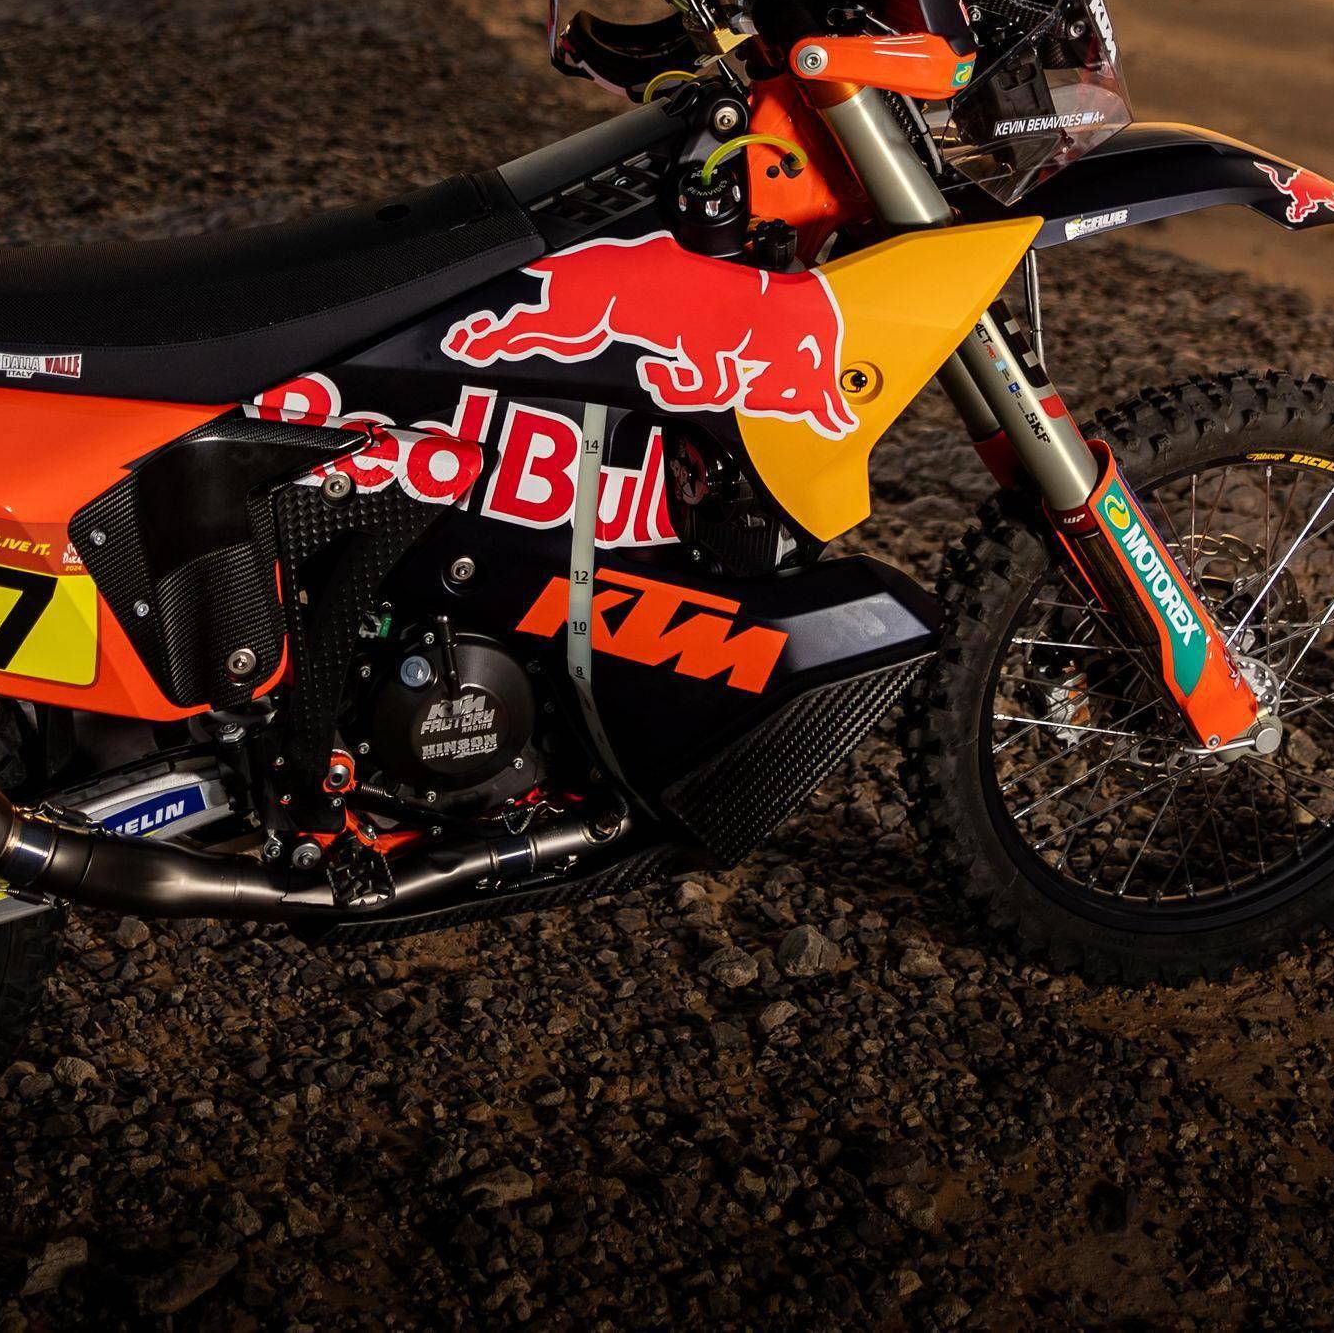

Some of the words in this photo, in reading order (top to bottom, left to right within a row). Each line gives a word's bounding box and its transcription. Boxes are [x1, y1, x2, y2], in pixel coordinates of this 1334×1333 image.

[995, 120, 1025, 136] KEVIN
[1027, 113, 1083, 131] BENAVIDES
[1092, 111, 1105, 124] A+
[975, 321, 993, 344] ACT
[2, 354, 40, 371] DALLA
[45, 355, 80, 376] VALLE
[1025, 412, 1050, 443] SKF
[584, 439, 600, 451] 14
[1064, 513, 1085, 524] WP
[32, 542, 51, 555] IT.
[574, 570, 589, 581] 12
[1121, 522, 1200, 646] MOTOREX
[515, 568, 789, 694] KTM
[572, 621, 588, 632] 10
[575, 666, 584, 676] 8
[420, 709, 495, 735] FACTORY
[422, 733, 498, 757] HINSON
[115, 799, 185, 835] ELIN
